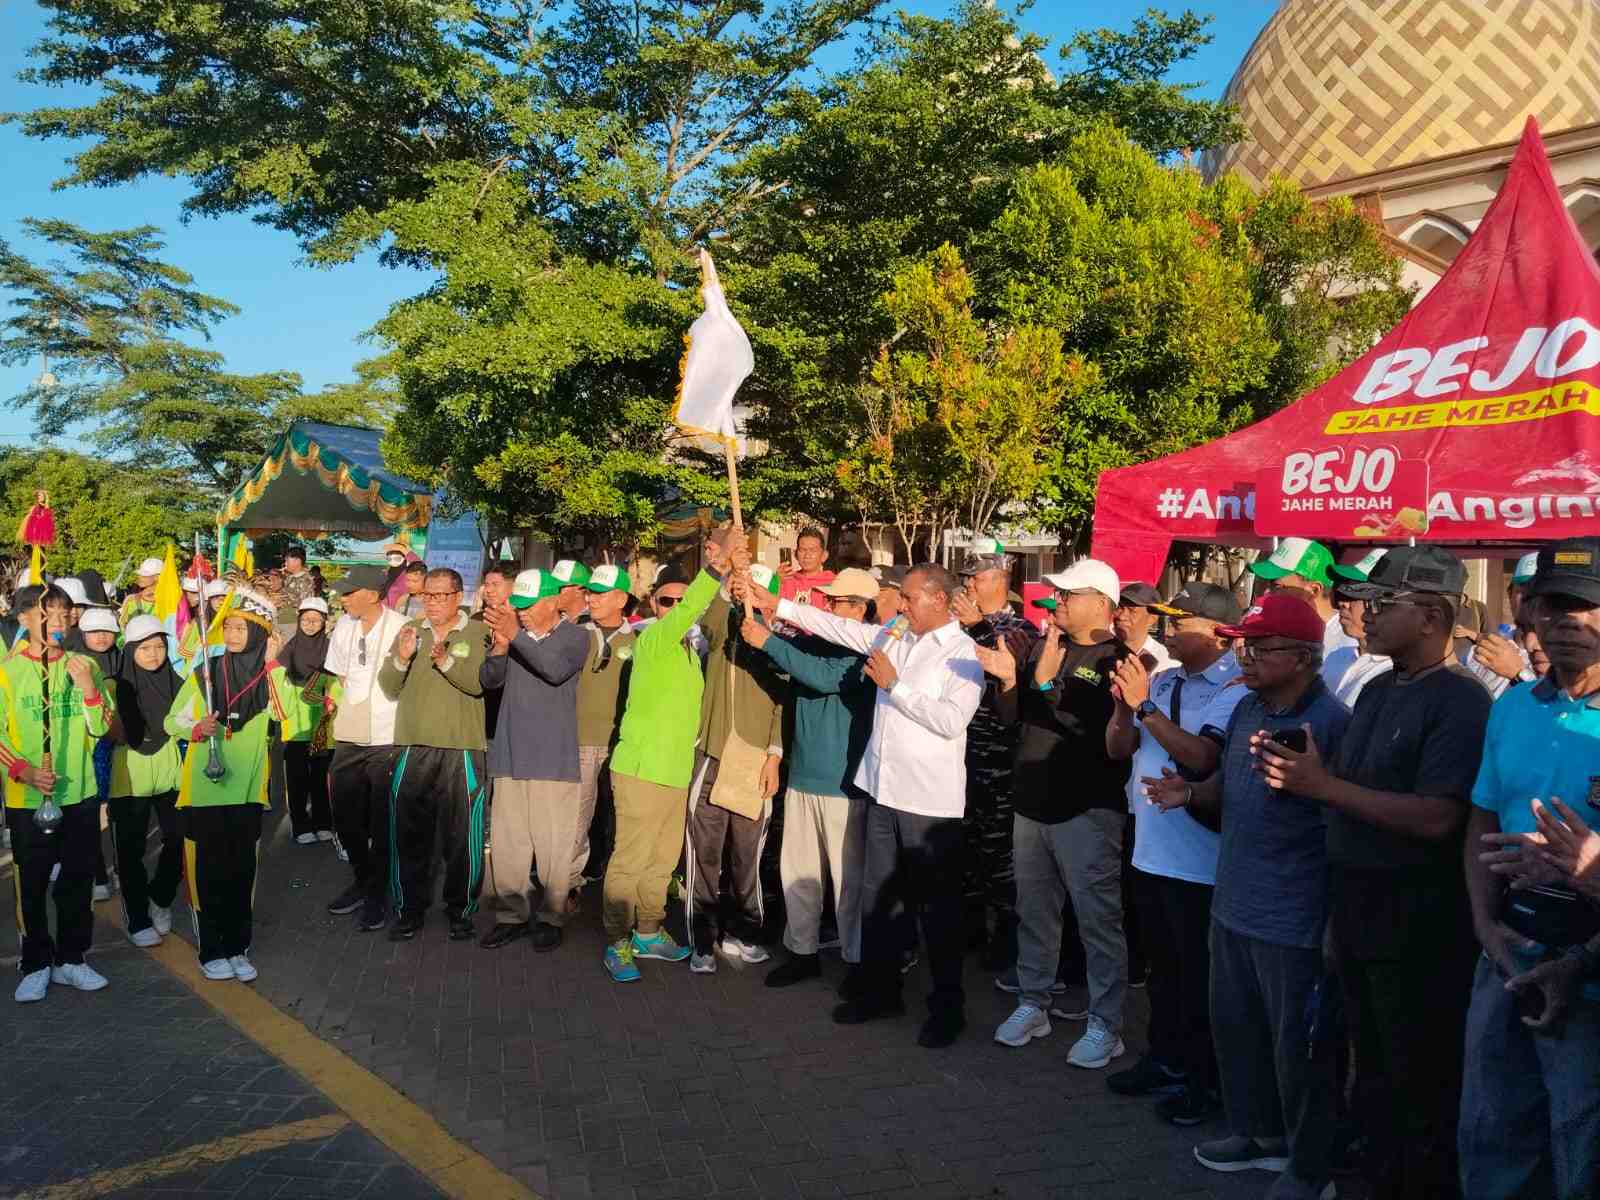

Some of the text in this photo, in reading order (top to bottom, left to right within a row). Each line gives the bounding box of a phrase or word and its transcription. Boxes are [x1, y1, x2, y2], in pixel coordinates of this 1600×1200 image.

[1352, 317, 1600, 404] BEJO
[1338, 387, 1589, 430] JAHE MERAH
[1281, 448, 1395, 495] BEJO
[1281, 495, 1393, 512] JAHE MERAH
